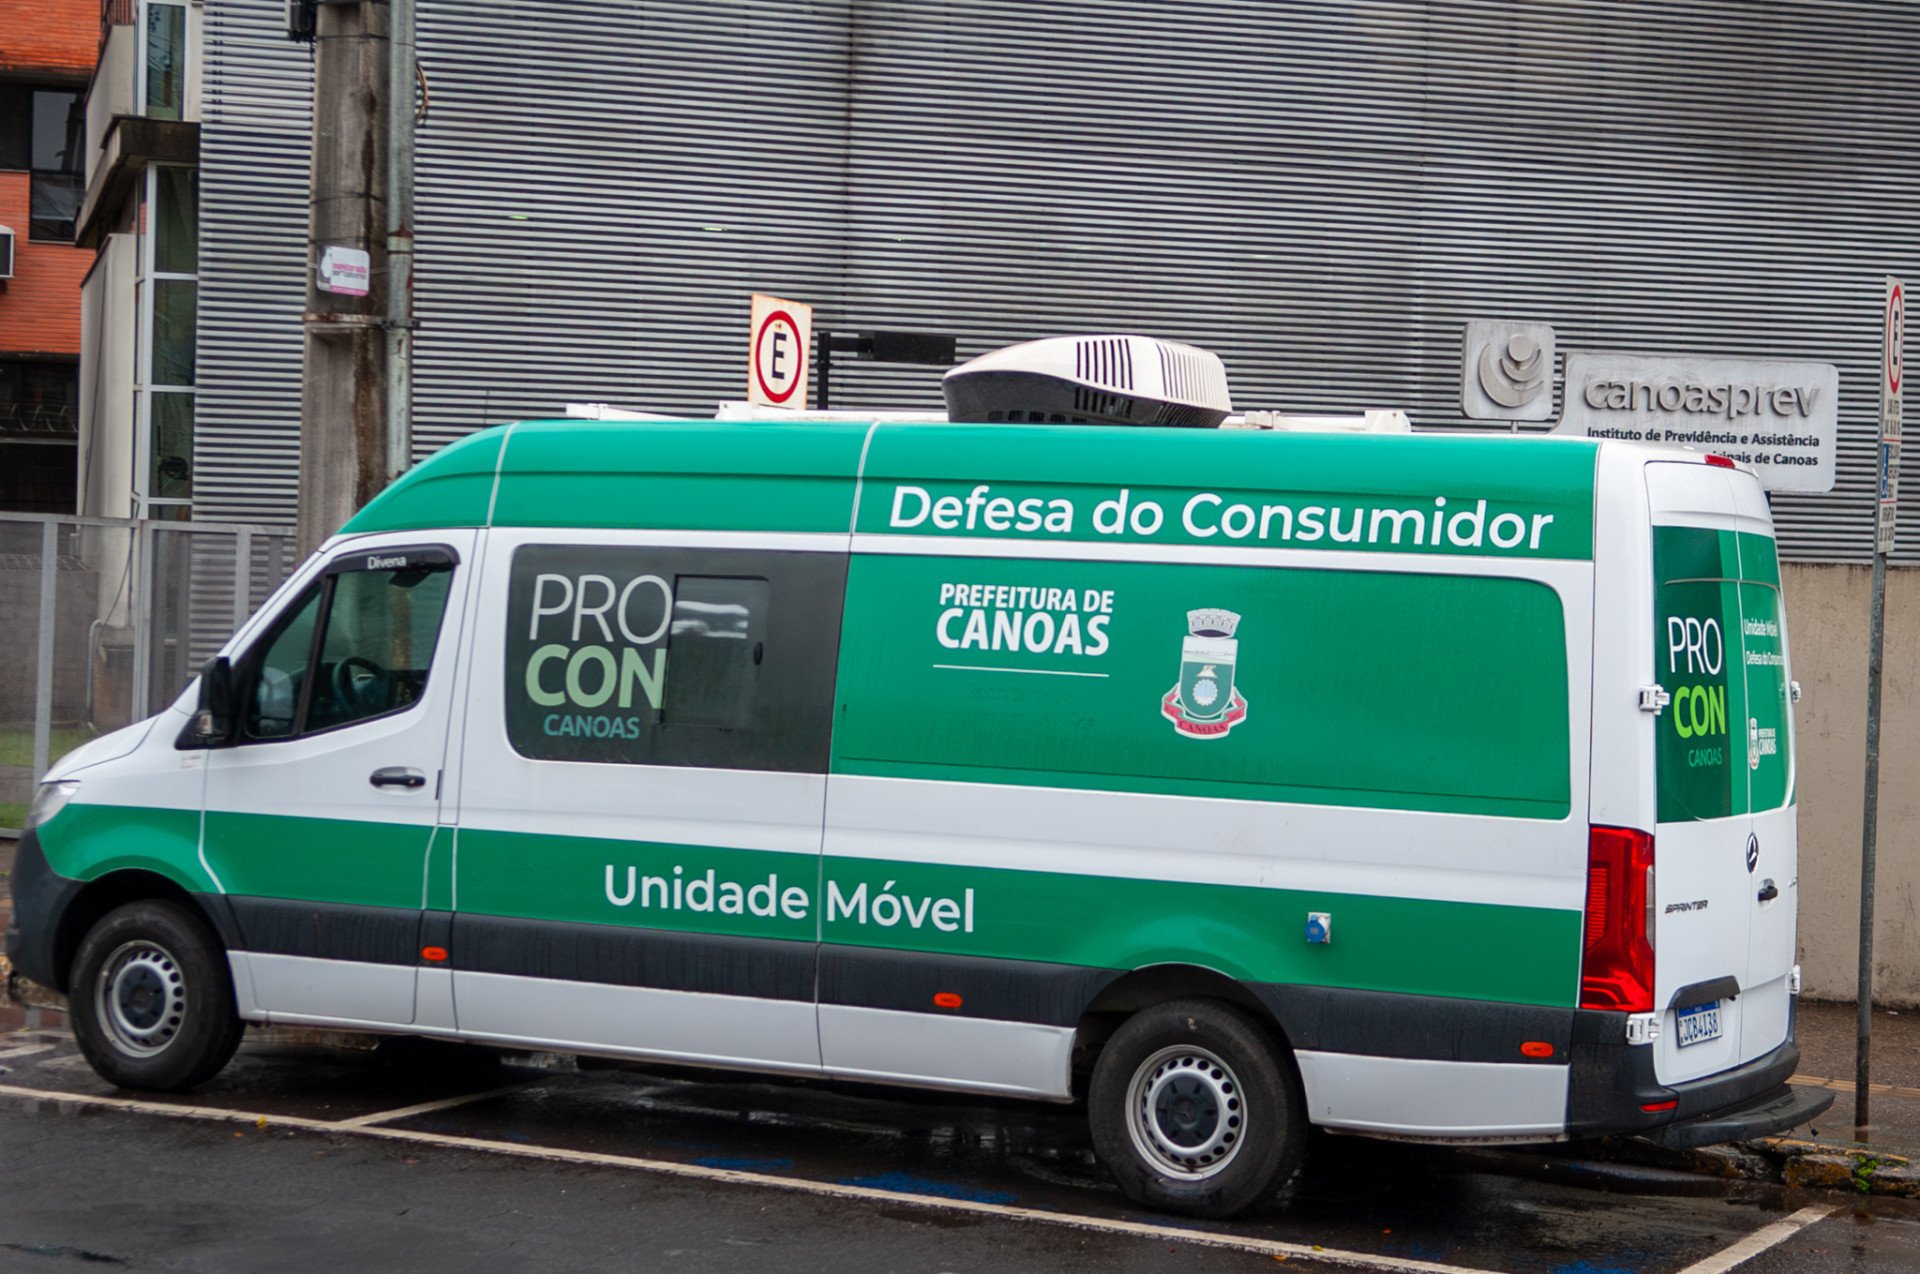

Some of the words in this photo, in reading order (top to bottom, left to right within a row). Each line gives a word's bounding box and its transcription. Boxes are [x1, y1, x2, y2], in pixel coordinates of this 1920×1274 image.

[771, 332, 788, 380] E
[1583, 379, 1820, 420] canoasprev
[1587, 427, 1642, 440] Instituto
[1645, 428, 1661, 441] de
[1664, 430, 1738, 444] Previdência
[1740, 434, 1749, 444] e
[1751, 433, 1820, 447] Assistência
[1754, 452, 1770, 464] de
[1773, 453, 1818, 466] Canoas
[889, 485, 1074, 533] Defesa
[1092, 488, 1164, 536] do
[1182, 493, 1554, 549] Consumidor
[367, 555, 407, 569] Divena
[529, 573, 673, 645] PRO
[940, 583, 1077, 612] PREFEITURA
[1083, 590, 1115, 613] DE
[936, 607, 1110, 656] CANOAS
[1667, 616, 1722, 675] PRO
[525, 644, 667, 709] CON
[544, 714, 640, 739] CANOAS
[1673, 685, 1726, 738] CON
[1688, 748, 1723, 767] CANOAS
[605, 864, 810, 920] Unidade
[827, 879, 975, 933] Móvel
[1664, 899, 1708, 914] SPRINTER
